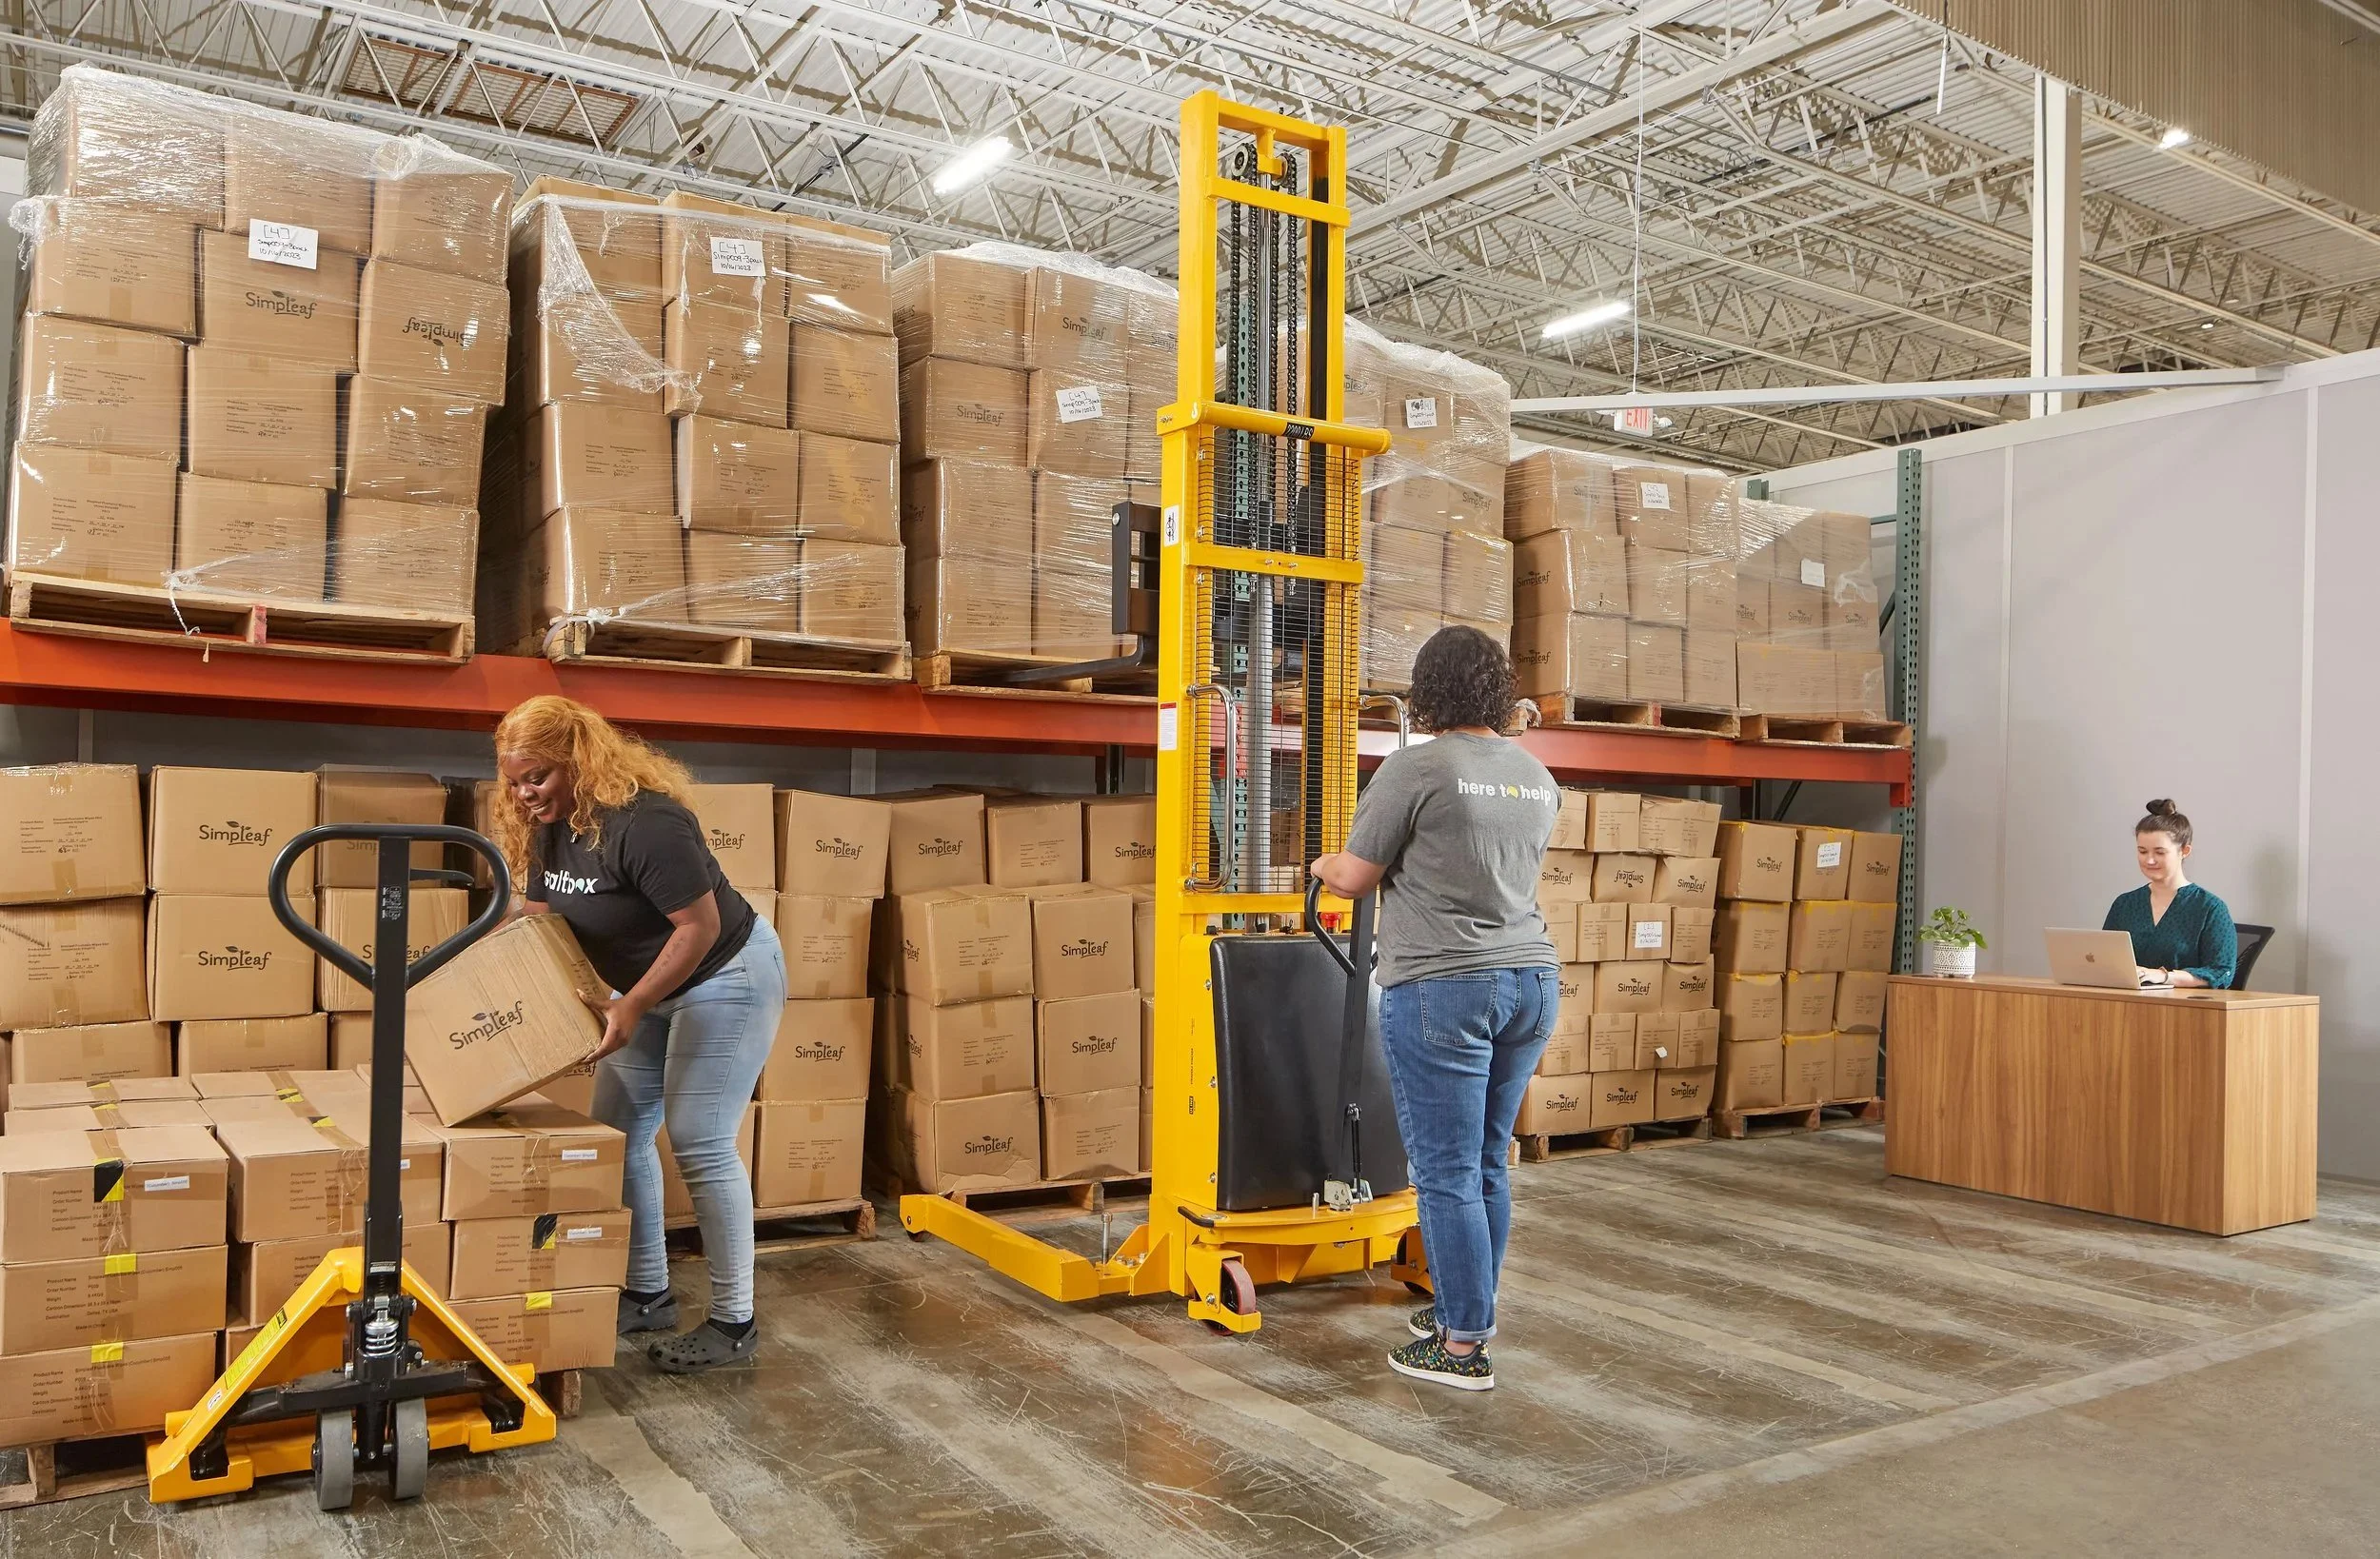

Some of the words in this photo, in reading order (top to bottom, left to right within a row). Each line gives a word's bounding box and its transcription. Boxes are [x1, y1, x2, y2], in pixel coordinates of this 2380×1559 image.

[246, 291, 317, 319] Simpleaf
[1061, 318, 1107, 340] Simpleaf
[956, 405, 1004, 426] Simpleaf
[1462, 493, 1491, 511] Simpleaf
[1516, 571, 1550, 587] Simpleaf
[1516, 650, 1550, 665] Simpleaf
[1458, 779, 1496, 797] here
[1499, 783, 1518, 799] to
[1519, 785, 1552, 806] help
[199, 824, 271, 847] Simpleaf
[816, 840, 863, 861] Simpleaf
[918, 840, 961, 857] Simpleaf
[1115, 844, 1156, 860] Simpleaf
[1756, 860, 1781, 873] Simpleaf
[1866, 864, 1890, 876] Simpleaf
[545, 870, 599, 895] saltbox
[1541, 871, 1573, 885] Simpleaf
[1613, 870, 1644, 885] Simpleaf
[1676, 878, 1706, 893] Simpleaf
[1061, 941, 1109, 958] Simpleaf
[198, 952, 270, 971] Simpleaf
[1558, 984, 1579, 997] pleaf
[1617, 983, 1651, 997] Simpleaf
[1679, 980, 1707, 994] Simpleaf
[449, 1001, 519, 1050] Simpleaf
[795, 1045, 845, 1062] Simpleaf
[1071, 1037, 1117, 1056] Simpleaf
[1606, 1092, 1638, 1106] Simpleaf
[1671, 1085, 1698, 1098] Simpleaf
[1545, 1098, 1579, 1113] Simpleaf
[964, 1137, 1013, 1155] Simpleaf
